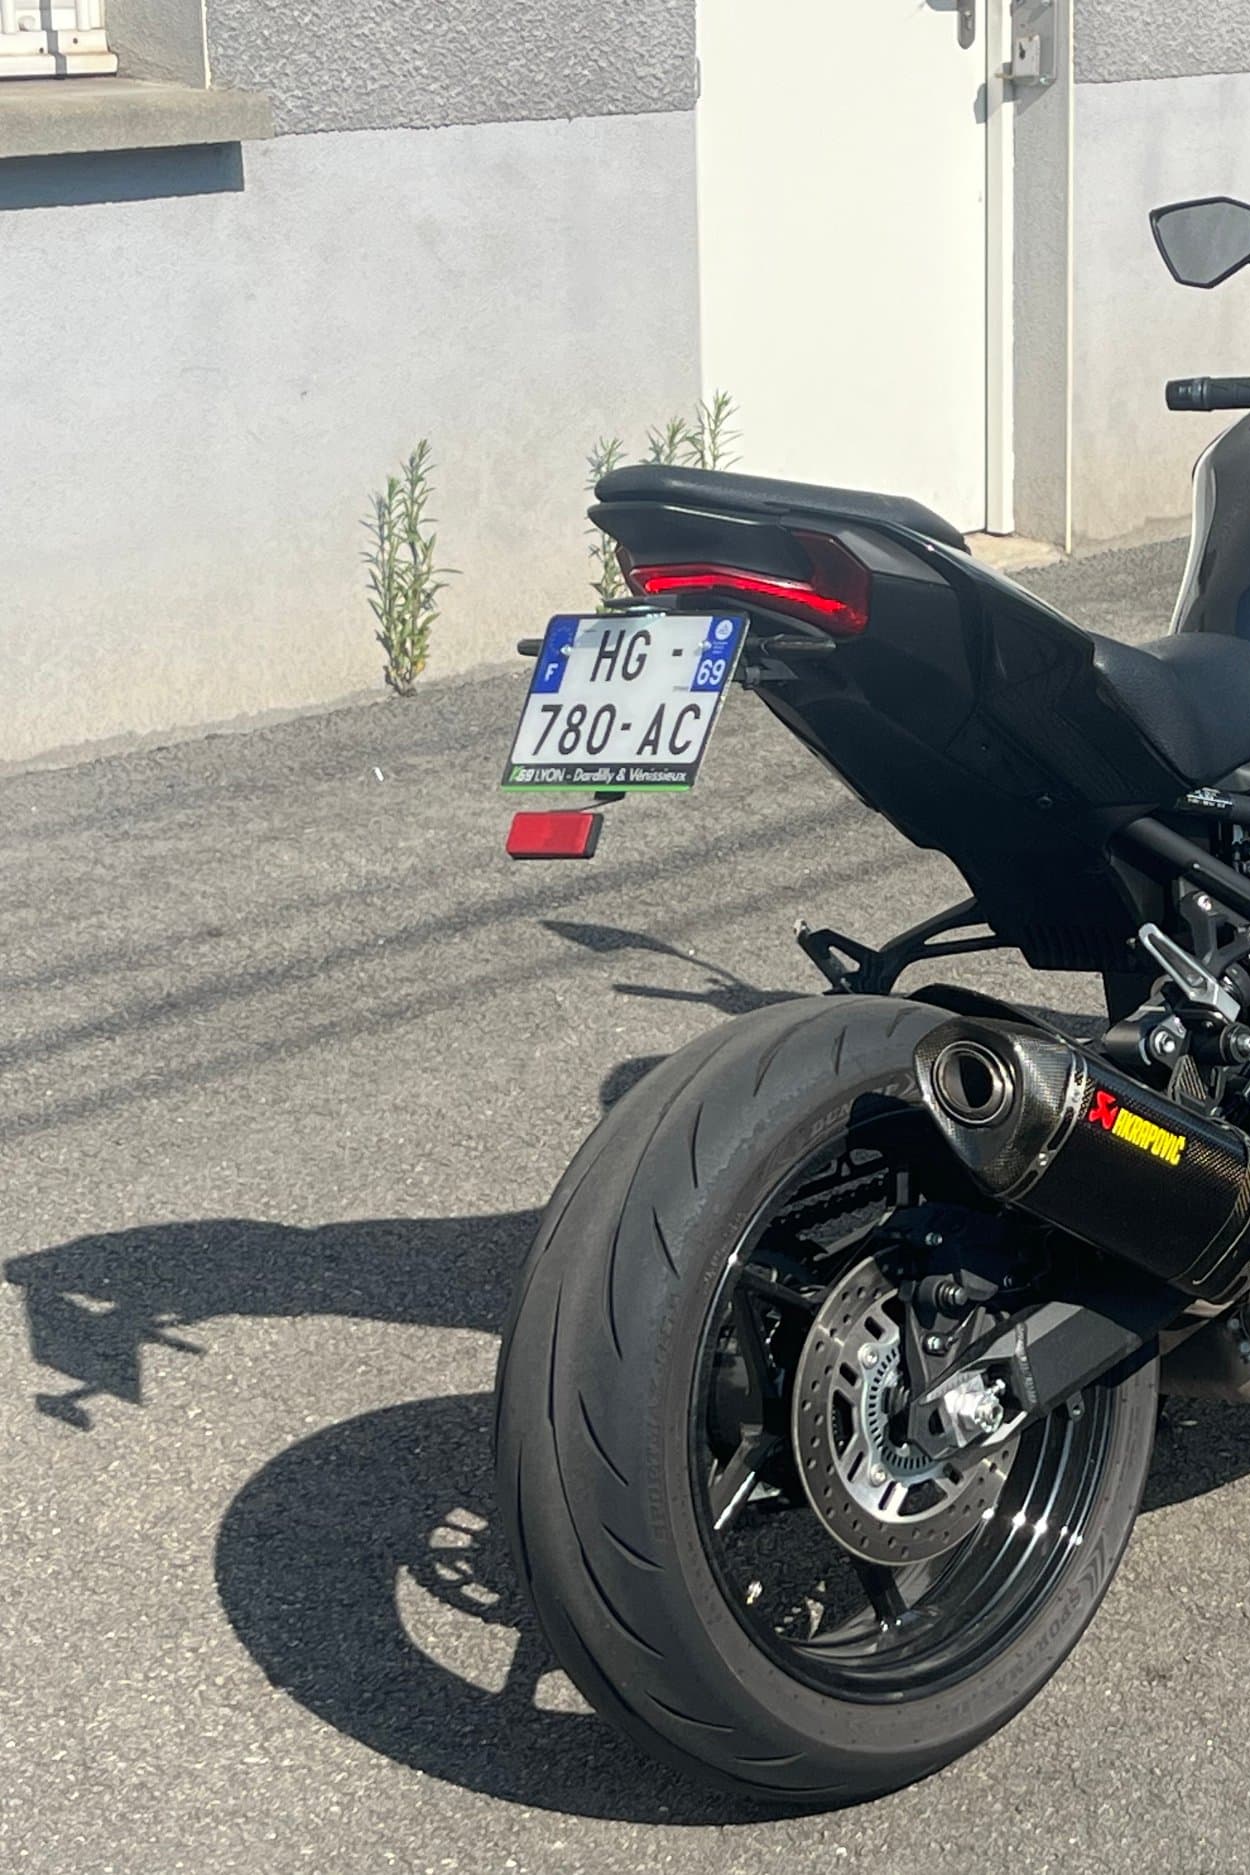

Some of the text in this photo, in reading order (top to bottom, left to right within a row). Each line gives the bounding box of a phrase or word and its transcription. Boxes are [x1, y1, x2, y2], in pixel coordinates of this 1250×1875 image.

[590, 629, 651, 682] HG
[544, 663, 558, 681] F
[696, 659, 726, 686] 69
[531, 702, 702, 757] 780-AC
[534, 767, 566, 782] LYON
[615, 767, 626, 781] &
